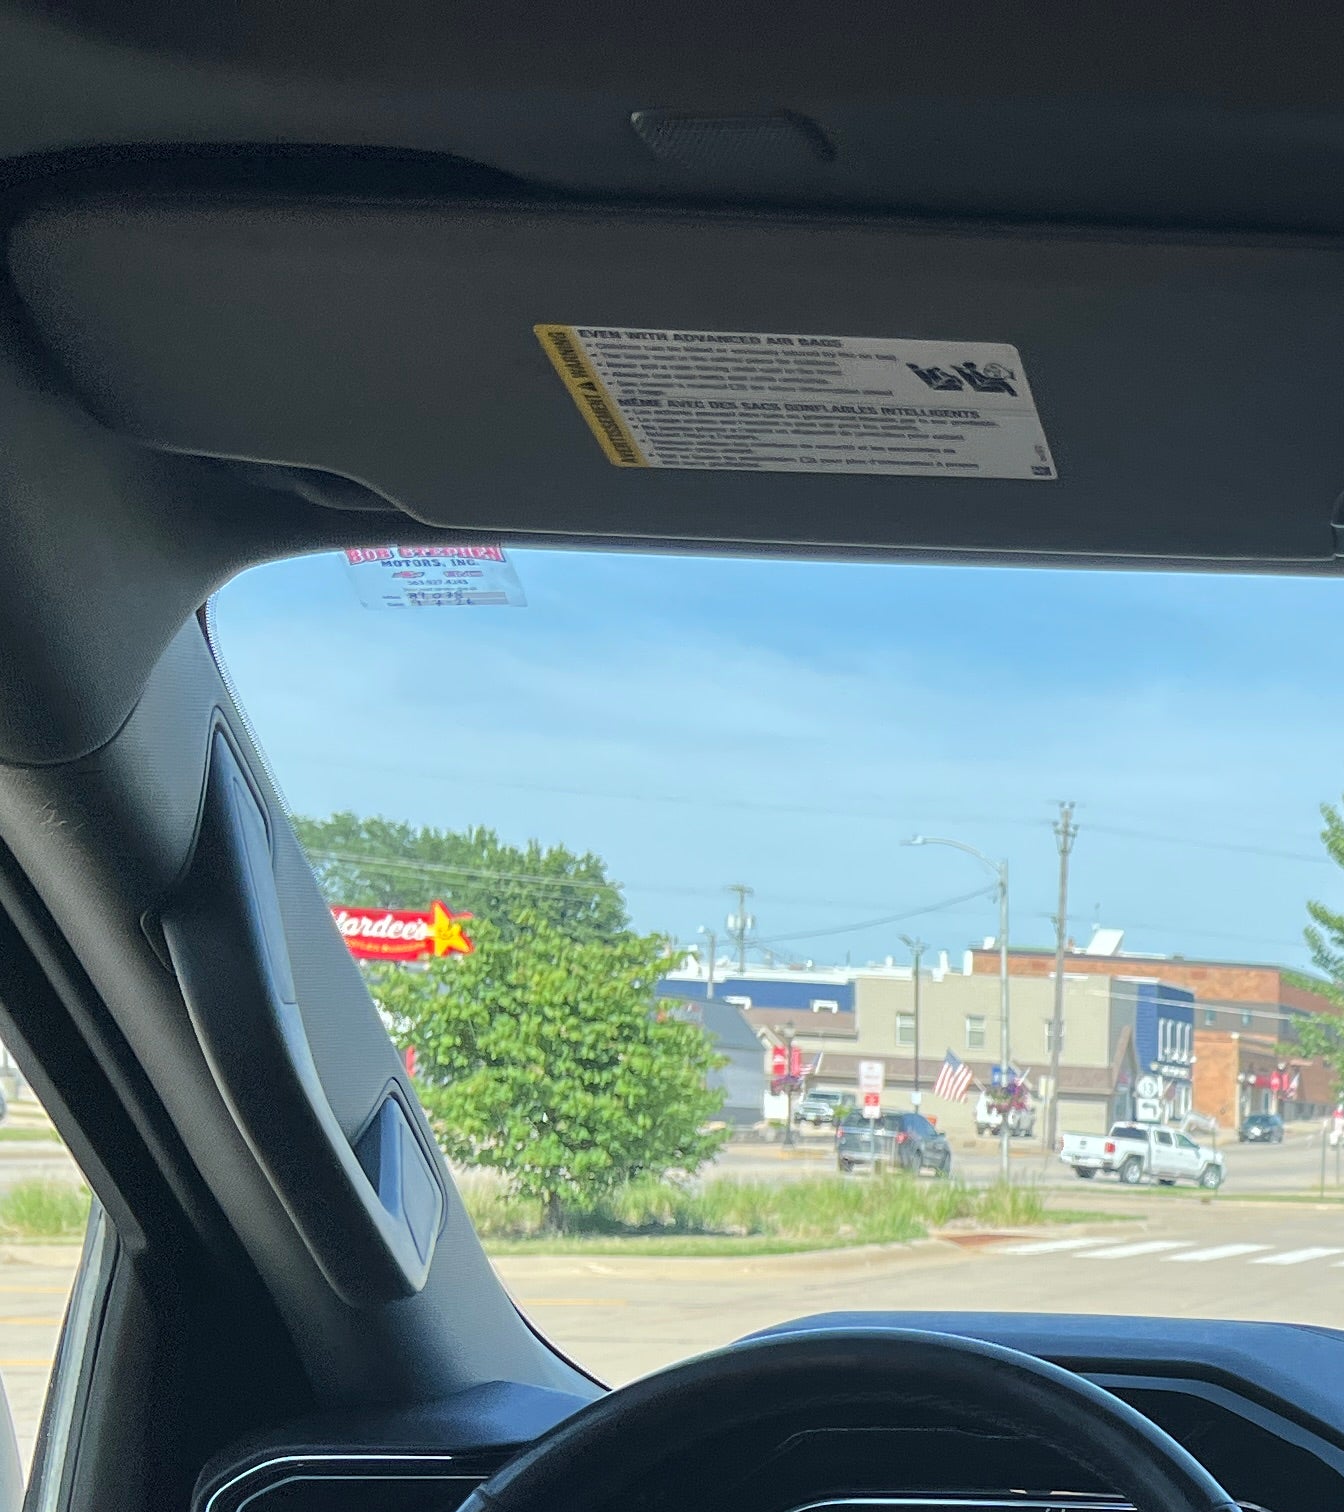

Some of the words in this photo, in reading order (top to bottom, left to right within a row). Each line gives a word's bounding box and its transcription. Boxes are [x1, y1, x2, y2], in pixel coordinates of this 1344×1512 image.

[580, 330, 621, 340] EVEN
[626, 331, 667, 342] WITH
[673, 333, 761, 345] ADVANCED
[767, 336, 794, 346] AIR
[799, 337, 842, 348] BAGS
